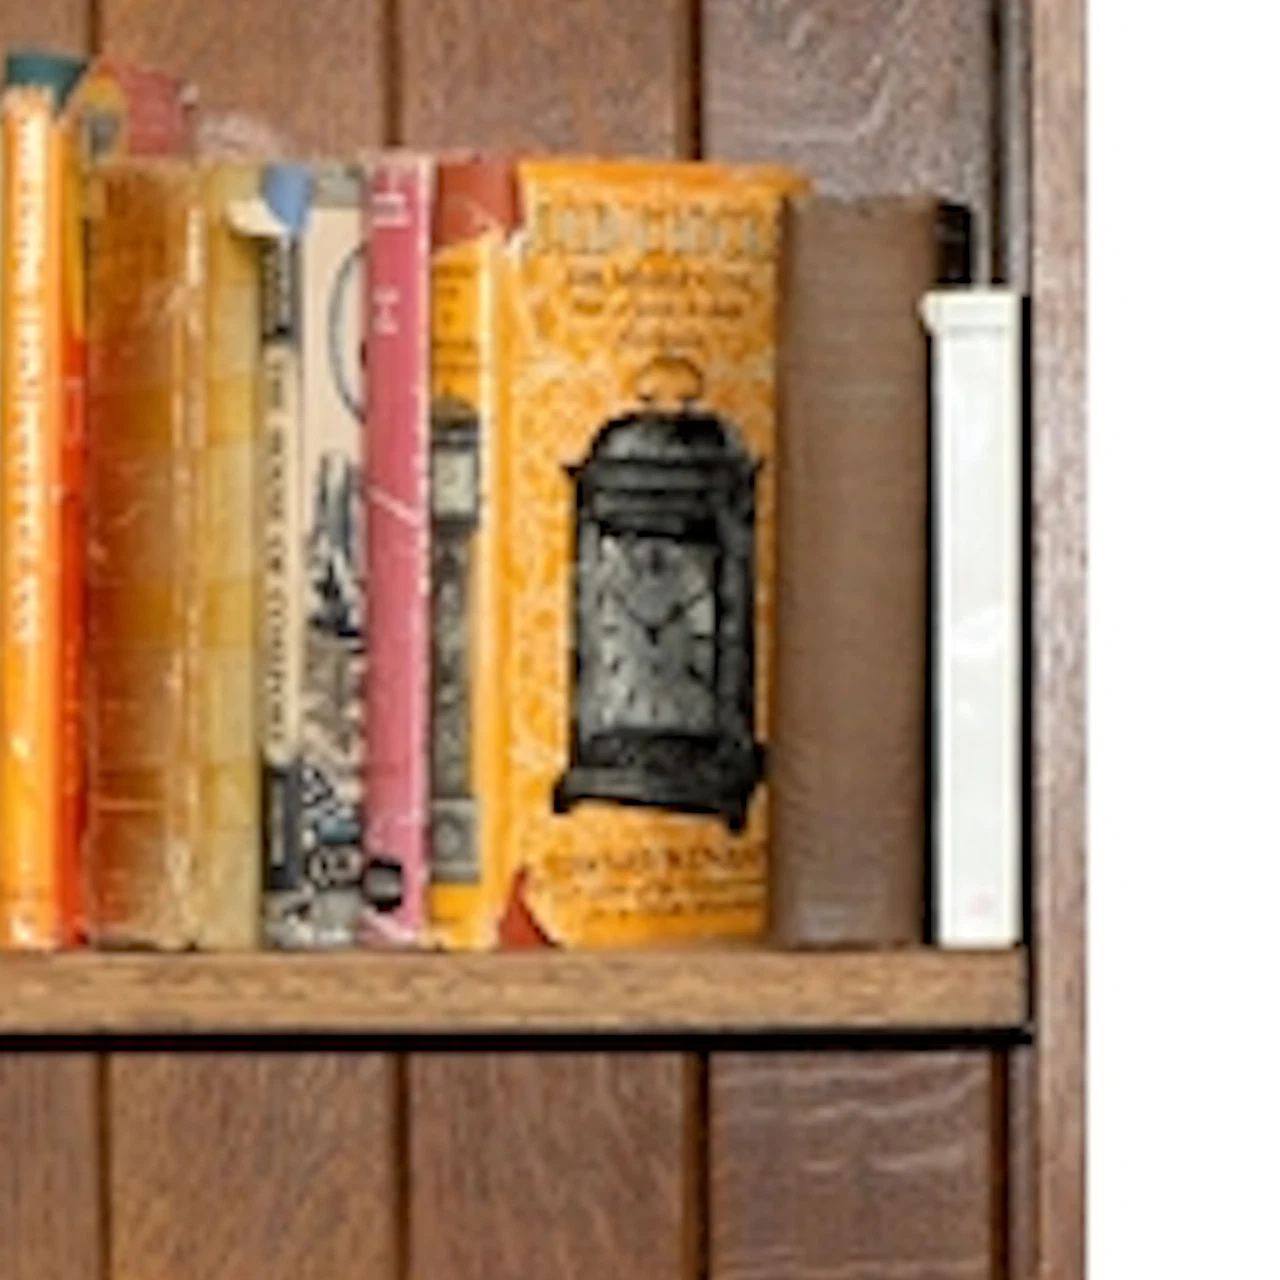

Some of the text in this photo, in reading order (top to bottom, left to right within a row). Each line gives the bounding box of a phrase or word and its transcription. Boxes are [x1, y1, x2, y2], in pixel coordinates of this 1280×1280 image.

[267, 358, 286, 415] THE
[266, 431, 286, 525] HOUSE
[265, 536, 285, 577] OF
